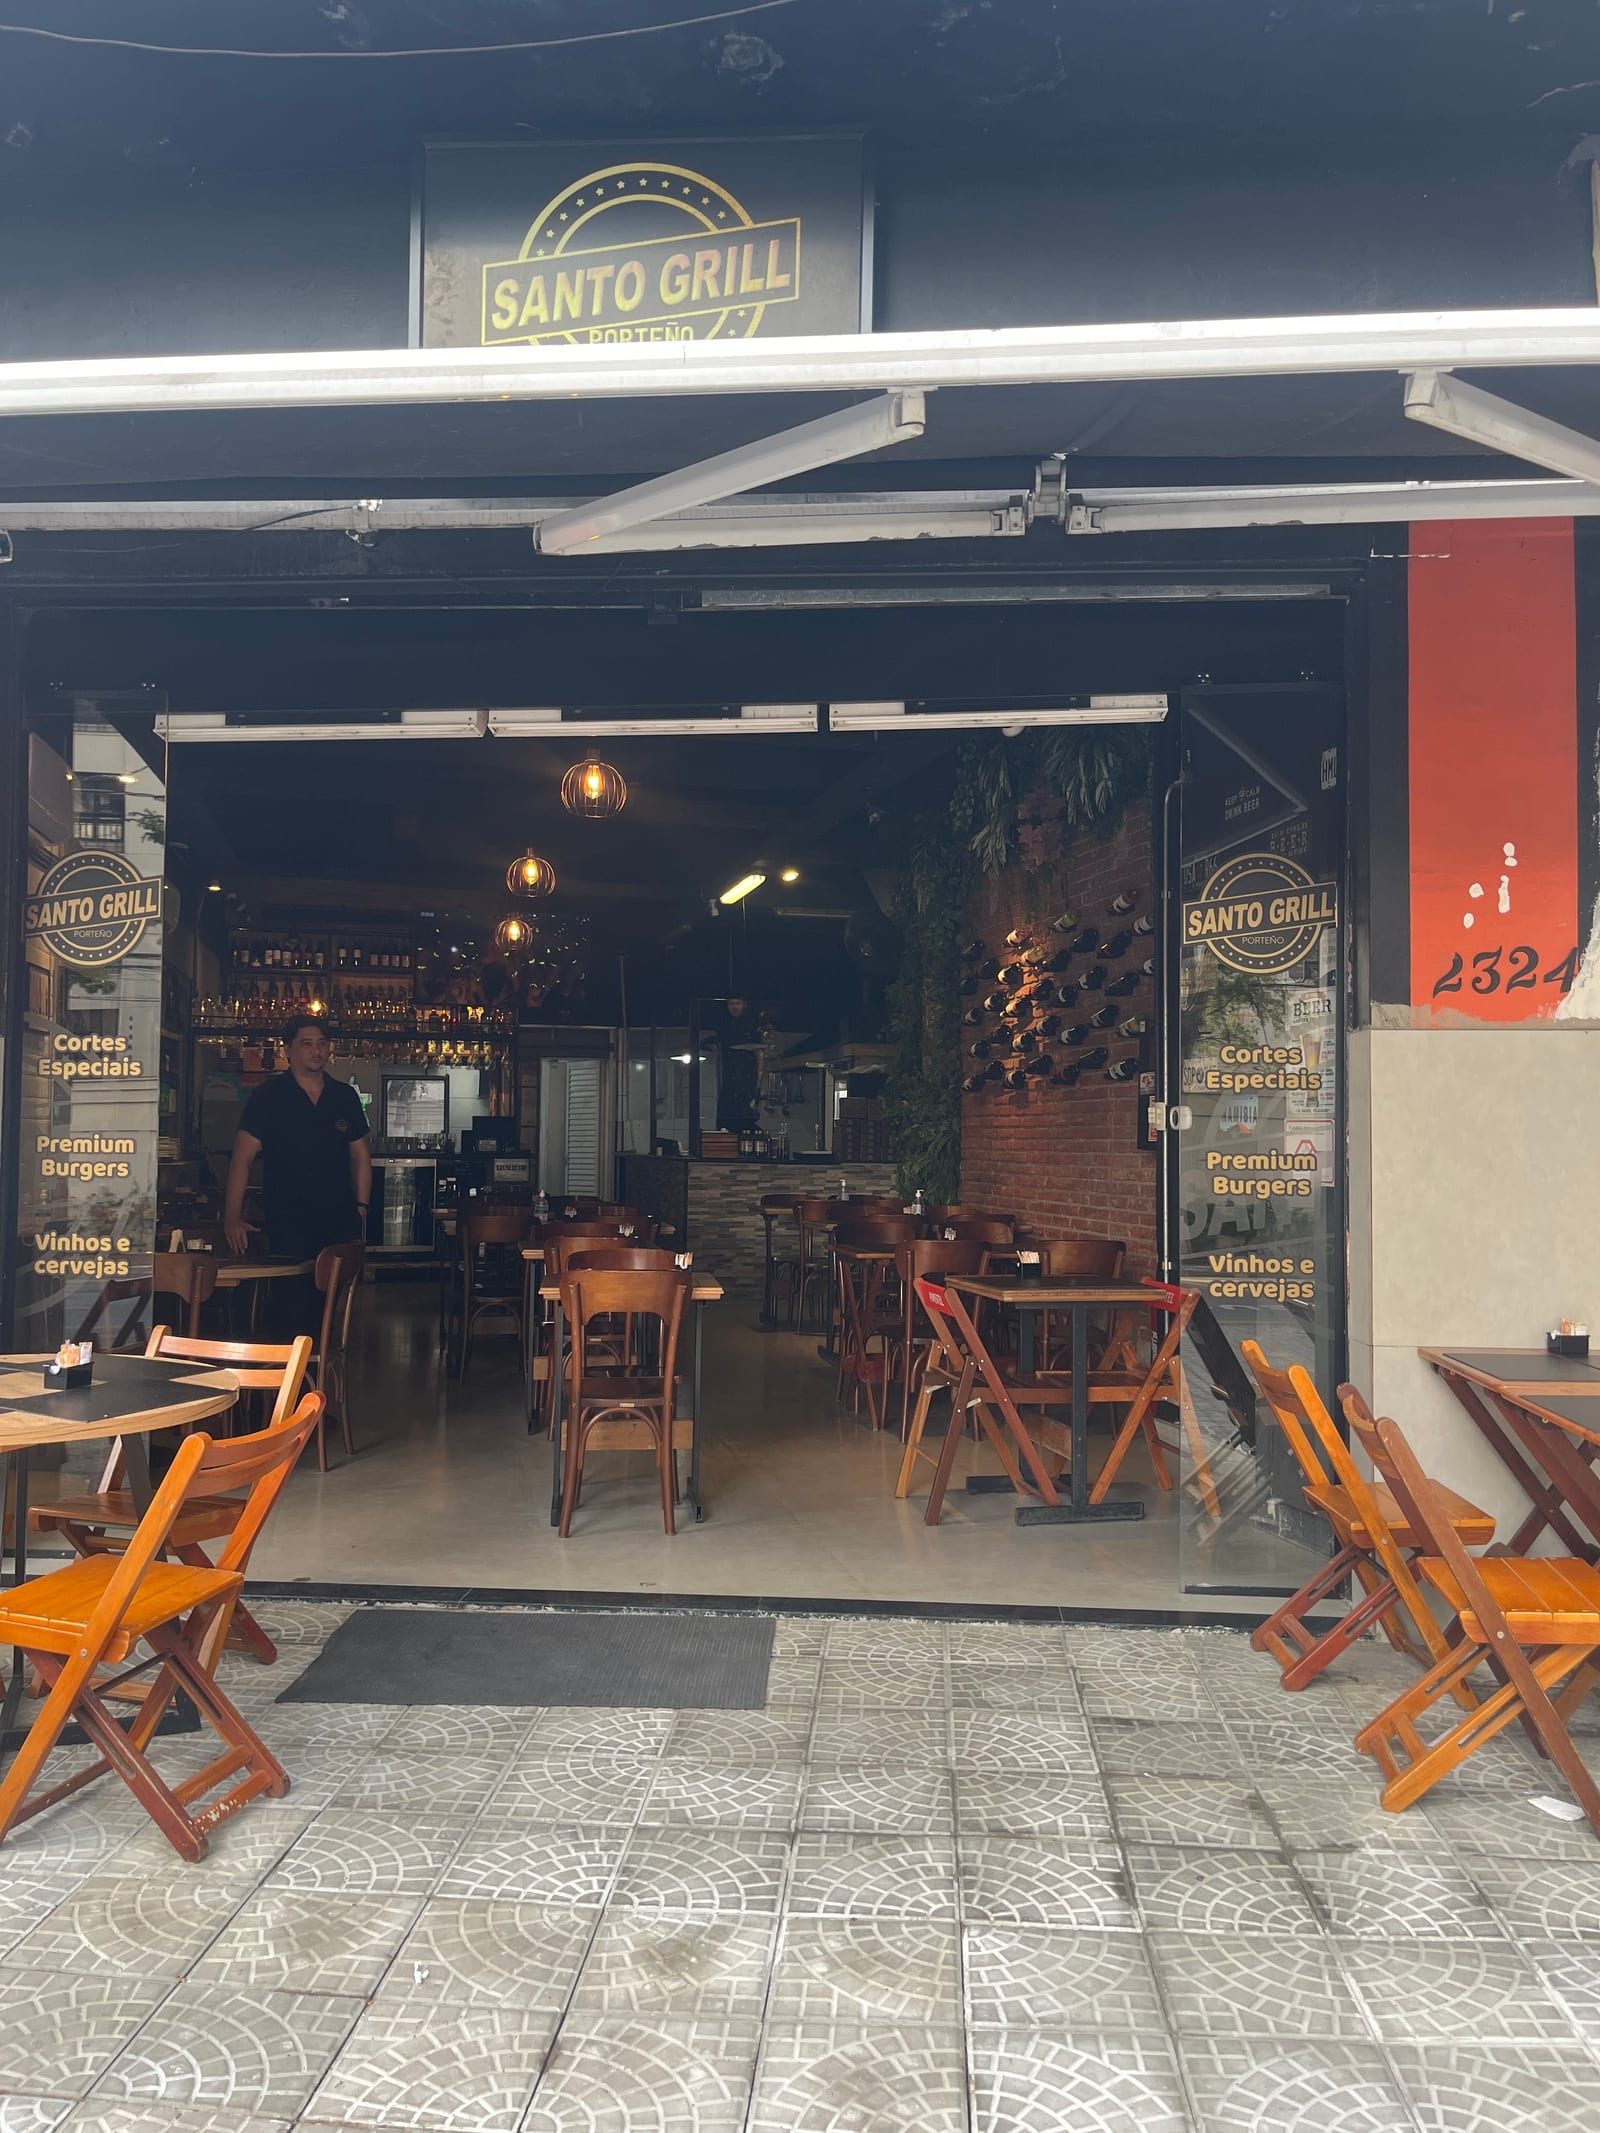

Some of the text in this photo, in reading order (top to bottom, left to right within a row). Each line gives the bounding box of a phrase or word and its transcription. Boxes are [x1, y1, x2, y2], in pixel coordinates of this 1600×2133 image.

[491, 239, 791, 330] SANTO GRILL
[25, 888, 157, 930] SANTO GRILL
[1188, 892, 1333, 937] SANTO GRILL
[73, 928, 113, 938] PORTEÑO
[1241, 935, 1285, 945] PORTEÑO
[1433, 945, 1577, 999] 2324
[1293, 998, 1333, 1017] BEER
[53, 1034, 127, 1052] Cortes
[1220, 1045, 1303, 1065] Cortes
[38, 1057, 142, 1080] Especiais
[1206, 1069, 1322, 1094] Especiais
[37, 1134, 135, 1153] Premium
[41, 1159, 129, 1181] Burgers
[1207, 1150, 1317, 1171] Premium
[1213, 1176, 1312, 1199] Burgers
[34, 1233, 130, 1252] Vinhos e
[34, 1256, 129, 1280] cervejas
[1209, 1253, 1315, 1275] Vinhos e
[1209, 1278, 1315, 1302] cervejas
